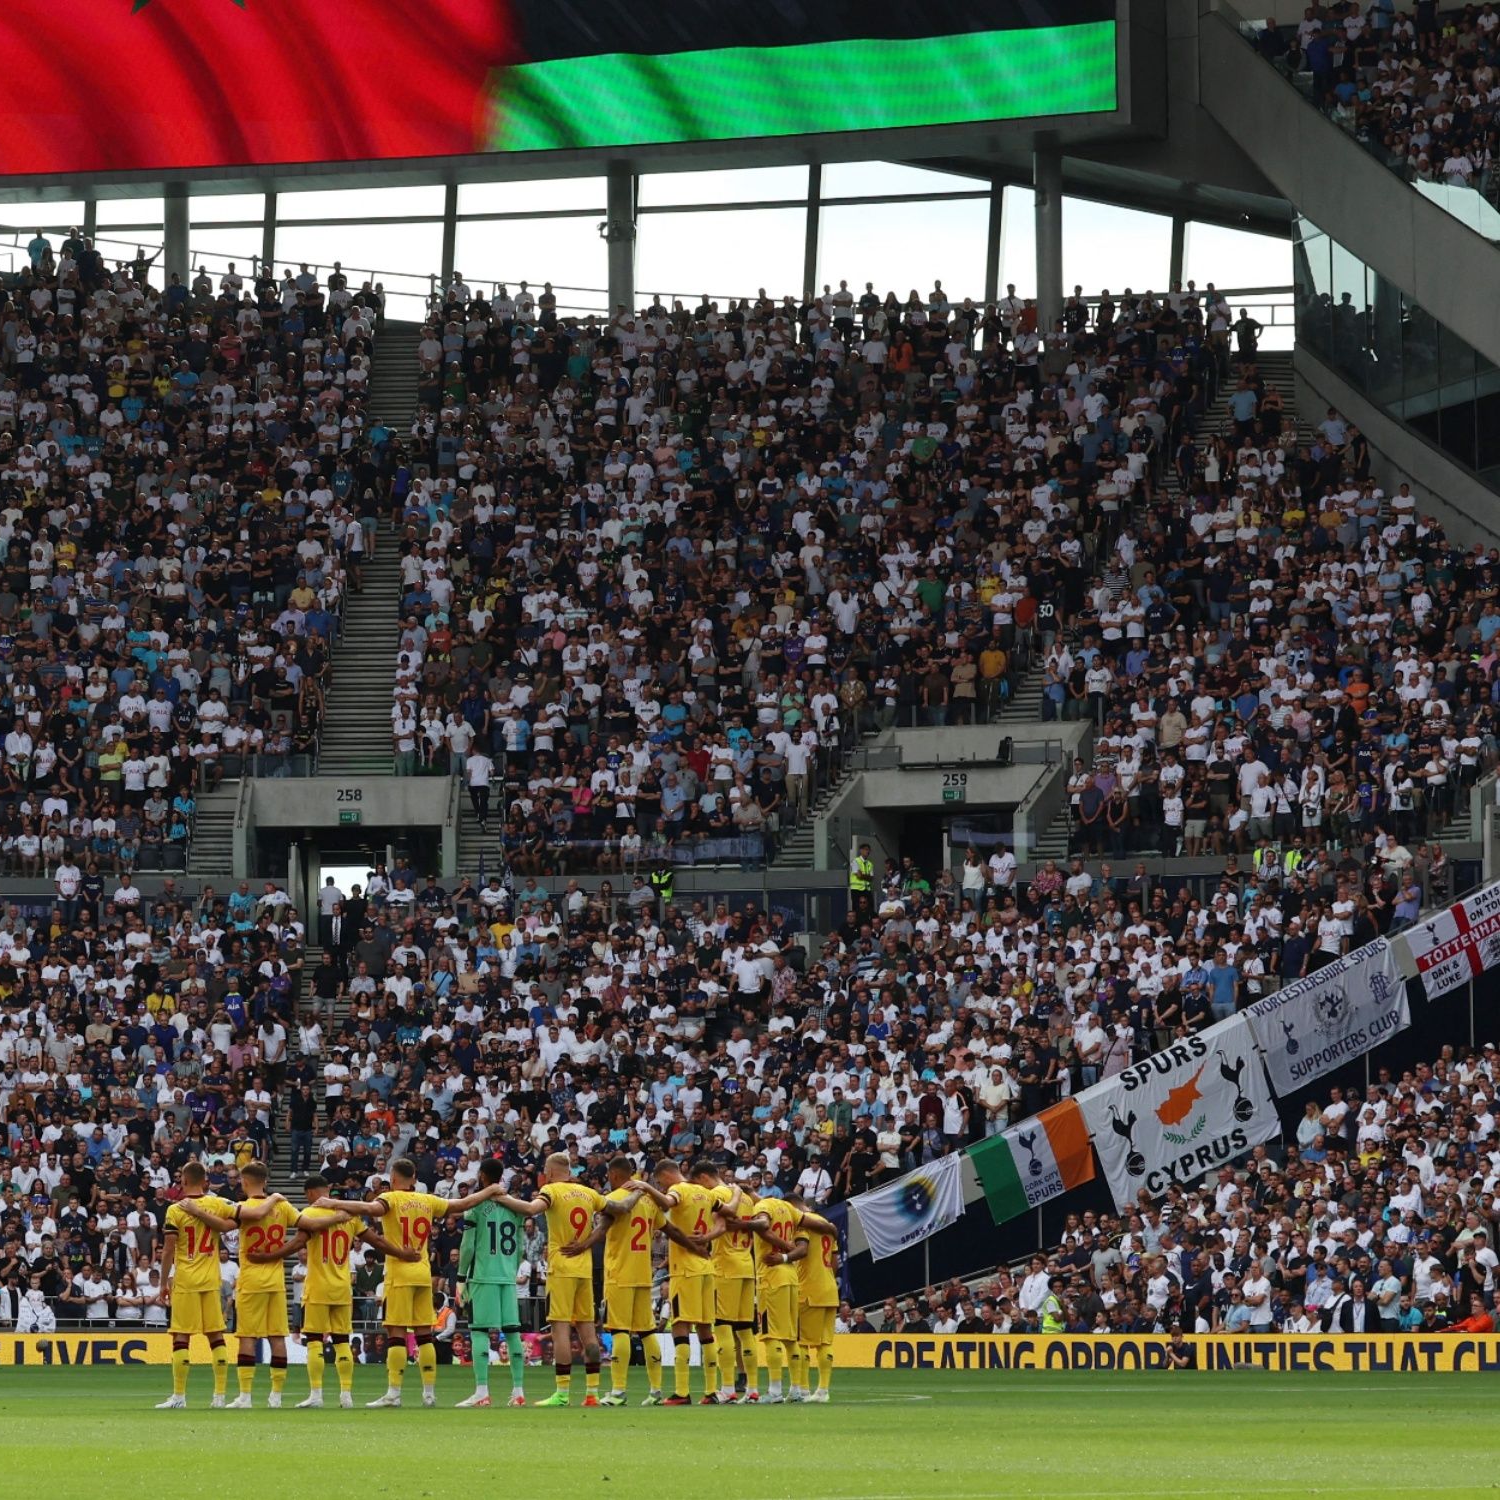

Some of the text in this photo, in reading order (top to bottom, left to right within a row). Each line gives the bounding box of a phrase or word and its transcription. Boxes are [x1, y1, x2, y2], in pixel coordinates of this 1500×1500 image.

[1039, 604, 1054, 618] 30
[337, 789, 362, 801] 258
[943, 774, 967, 786] 259
[1469, 911, 1484, 921] ON
[1251, 958, 1349, 1018] WORCESTERSHIRE
[1350, 938, 1388, 966] SPURS
[1432, 960, 1460, 980] DAN &
[1436, 971, 1463, 990] LUKE
[1290, 1029, 1368, 1081] SUPPORTERS
[1369, 1009, 1400, 1037] CLUB
[1120, 1036, 1207, 1091] SPURS
[1146, 1128, 1248, 1193] CYPRUS
[1025, 1170, 1060, 1192] CORK CITY
[1028, 1181, 1064, 1205] SPURS
[400, 1216, 431, 1251] 19
[570, 1207, 587, 1241] 9
[694, 1208, 707, 1236] 6
[185, 1226, 215, 1260] 14
[246, 1224, 284, 1254] 28
[320, 1230, 349, 1265] 10
[487, 1221, 516, 1255] 18
[822, 1235, 832, 1268] 8
[14, 1340, 148, 1365] LIVES
[875, 1340, 1035, 1369] CREATING
[1343, 1341, 1444, 1371] THAT
